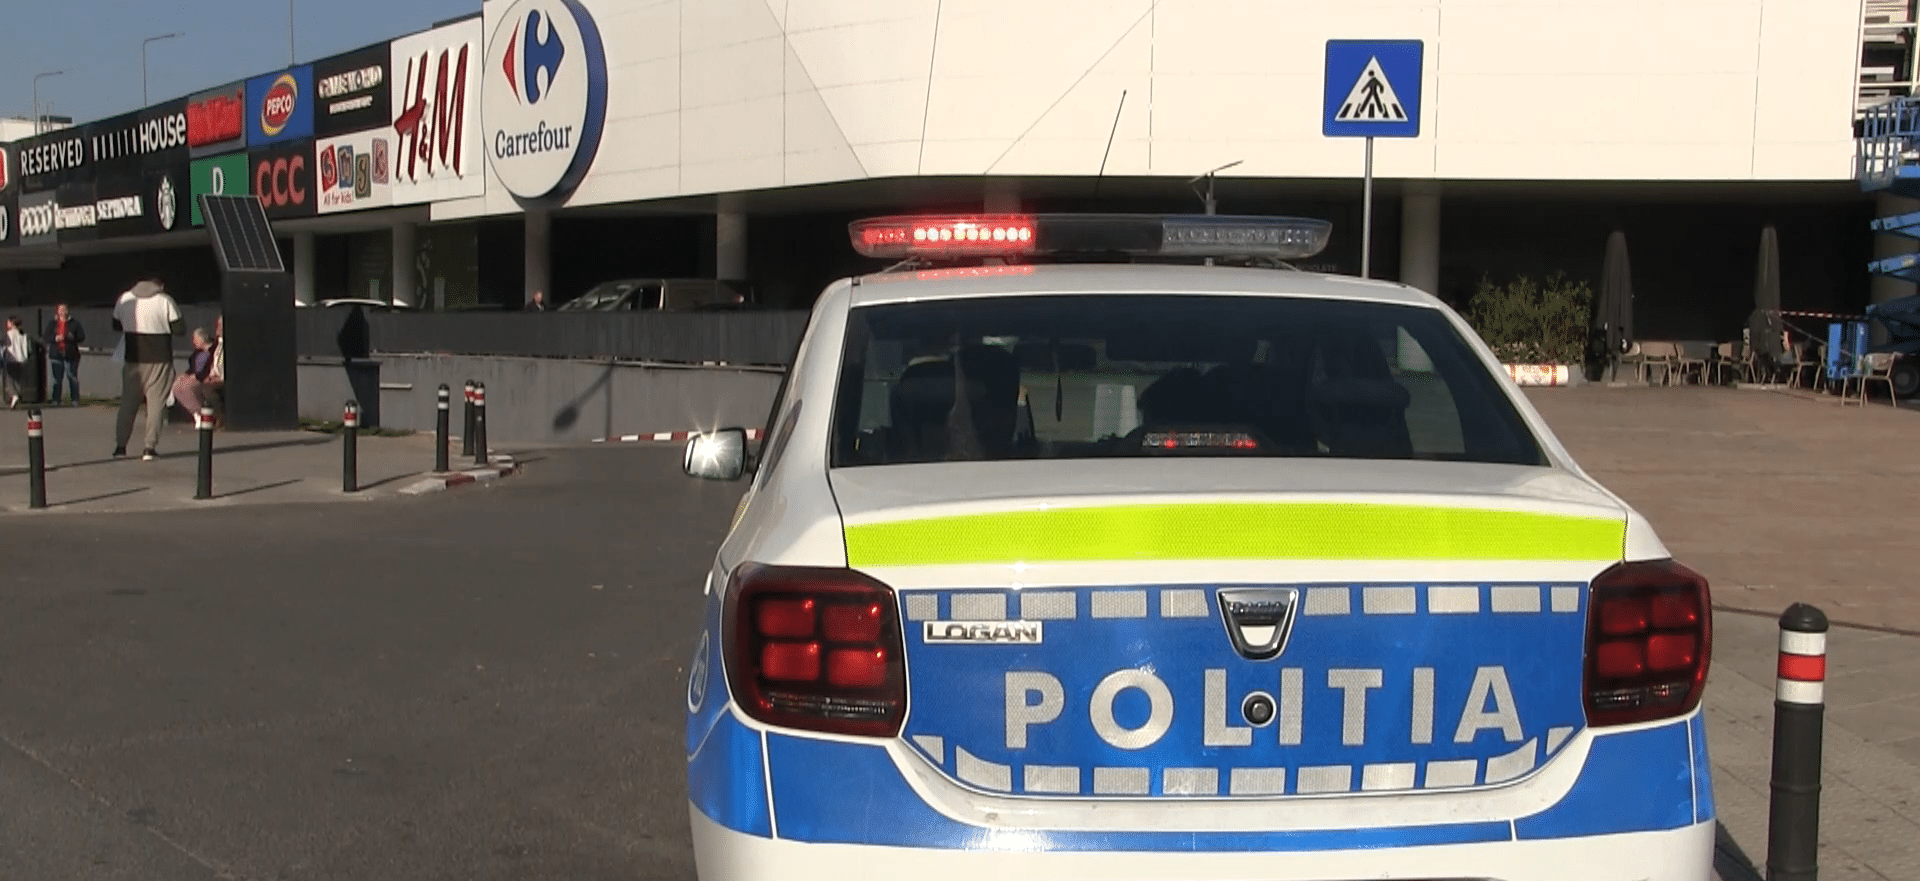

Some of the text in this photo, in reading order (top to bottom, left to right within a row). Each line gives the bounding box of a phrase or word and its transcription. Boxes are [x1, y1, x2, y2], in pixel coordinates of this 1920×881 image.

[266, 94, 292, 116] PEPCO
[394, 42, 469, 181] H&M
[21, 138, 83, 177] RESERVED
[495, 120, 572, 159] Carrefour
[255, 155, 306, 208] CCC
[926, 621, 1037, 641] LOGAN
[1004, 666, 1525, 749] POLITIA
